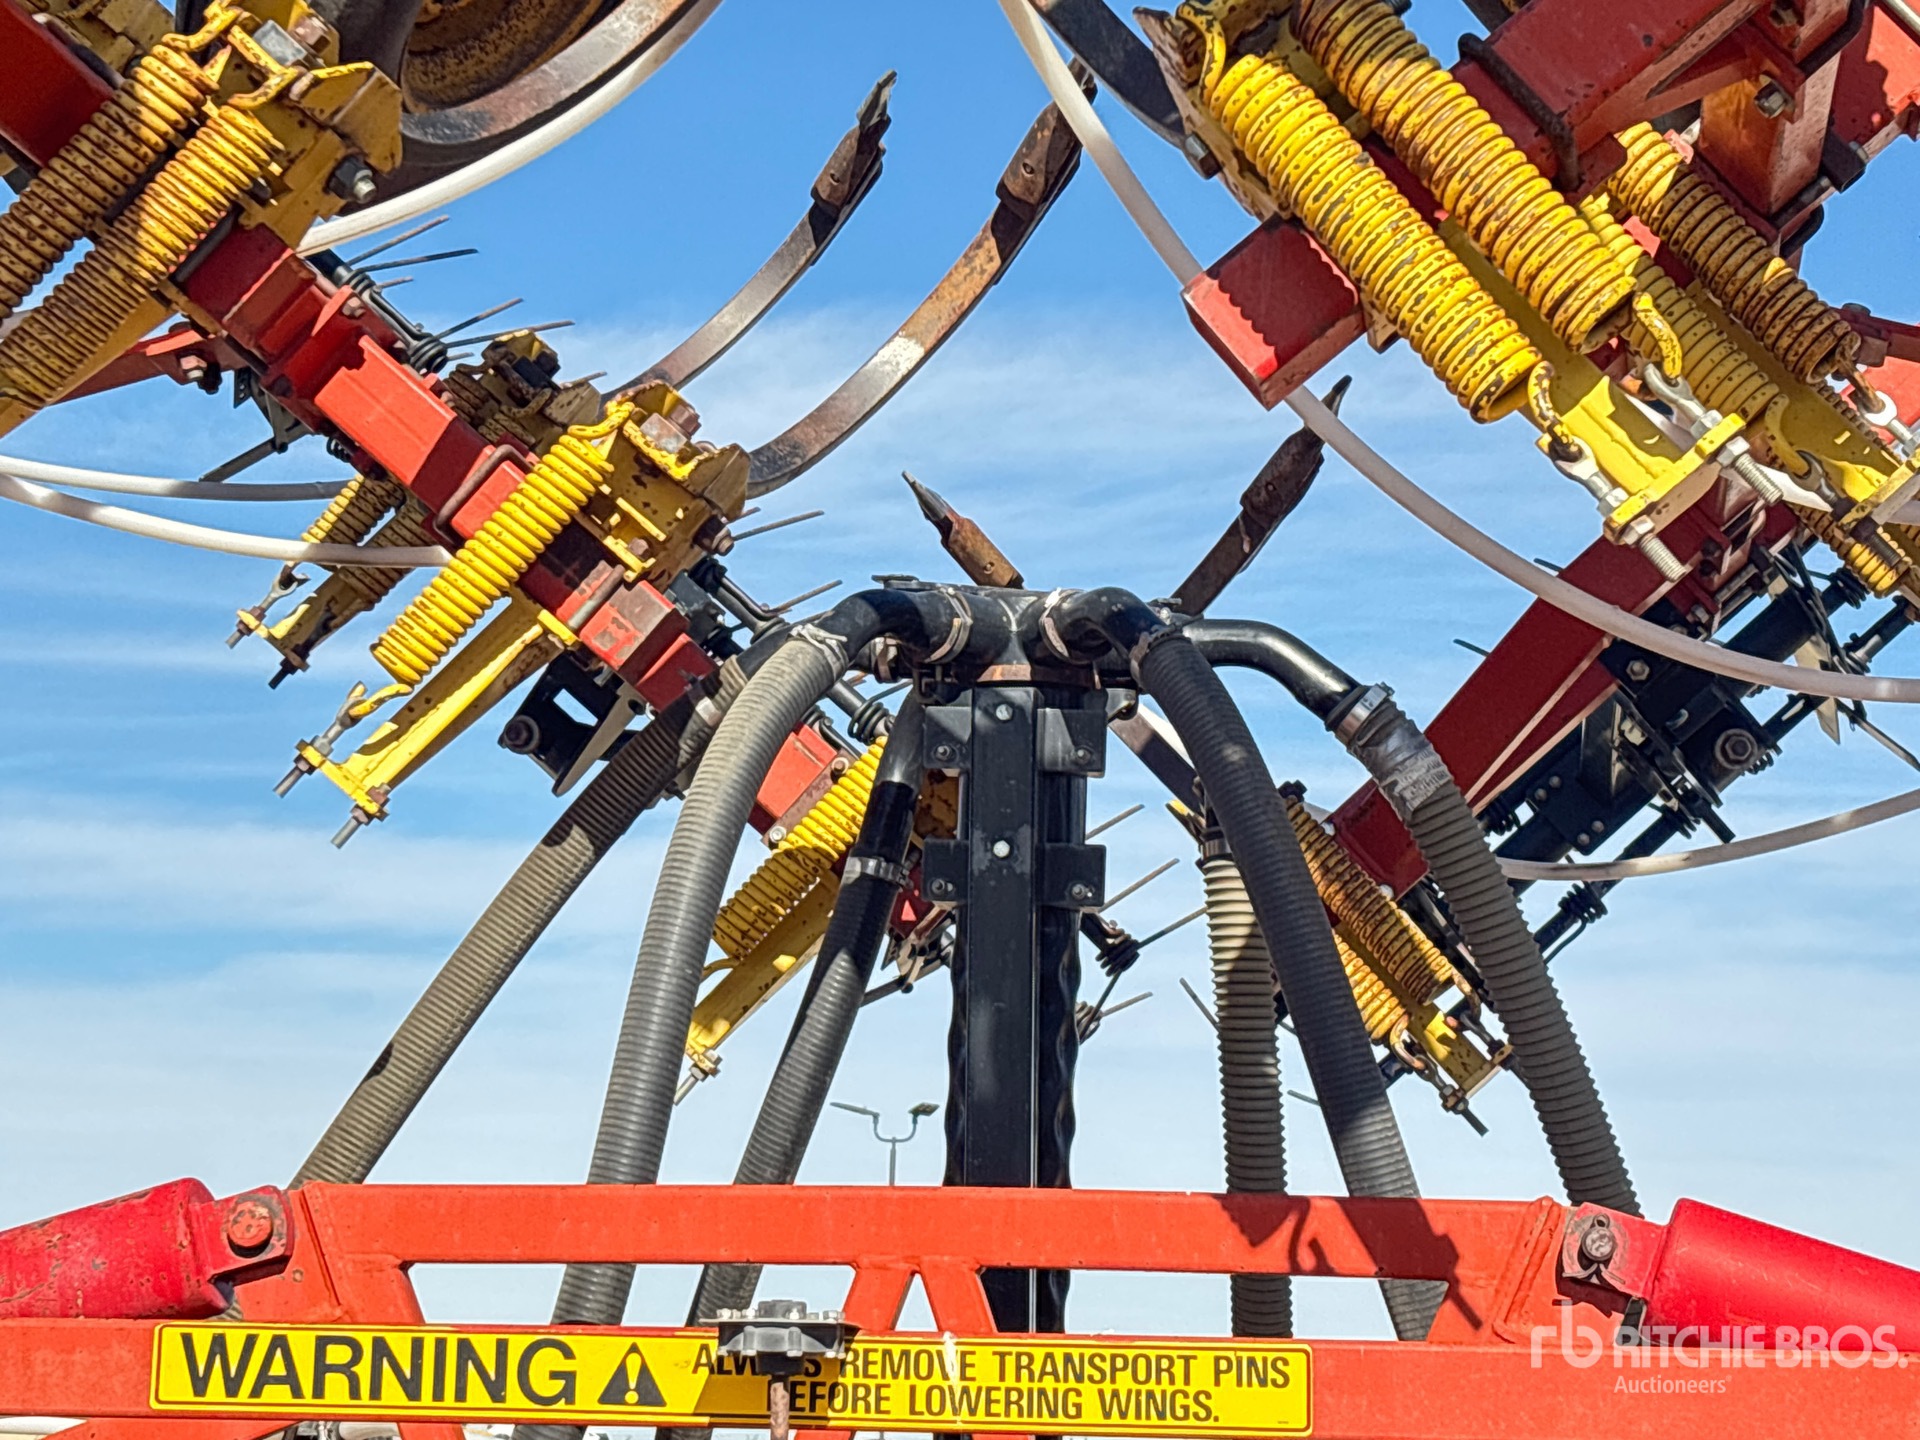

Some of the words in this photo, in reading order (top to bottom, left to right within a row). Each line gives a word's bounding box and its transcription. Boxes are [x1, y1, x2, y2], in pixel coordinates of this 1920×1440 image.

[180, 1332, 577, 1406] WARNING
[692, 1343, 823, 1377] ALWS
[840, 1348, 976, 1382] REMOVE
[992, 1351, 1198, 1387] TRANSPORT
[1213, 1355, 1291, 1389] PINS
[767, 1380, 891, 1416] EFORE
[909, 1384, 1083, 1419] LOWERING
[1097, 1388, 1219, 1422] WINGS.
